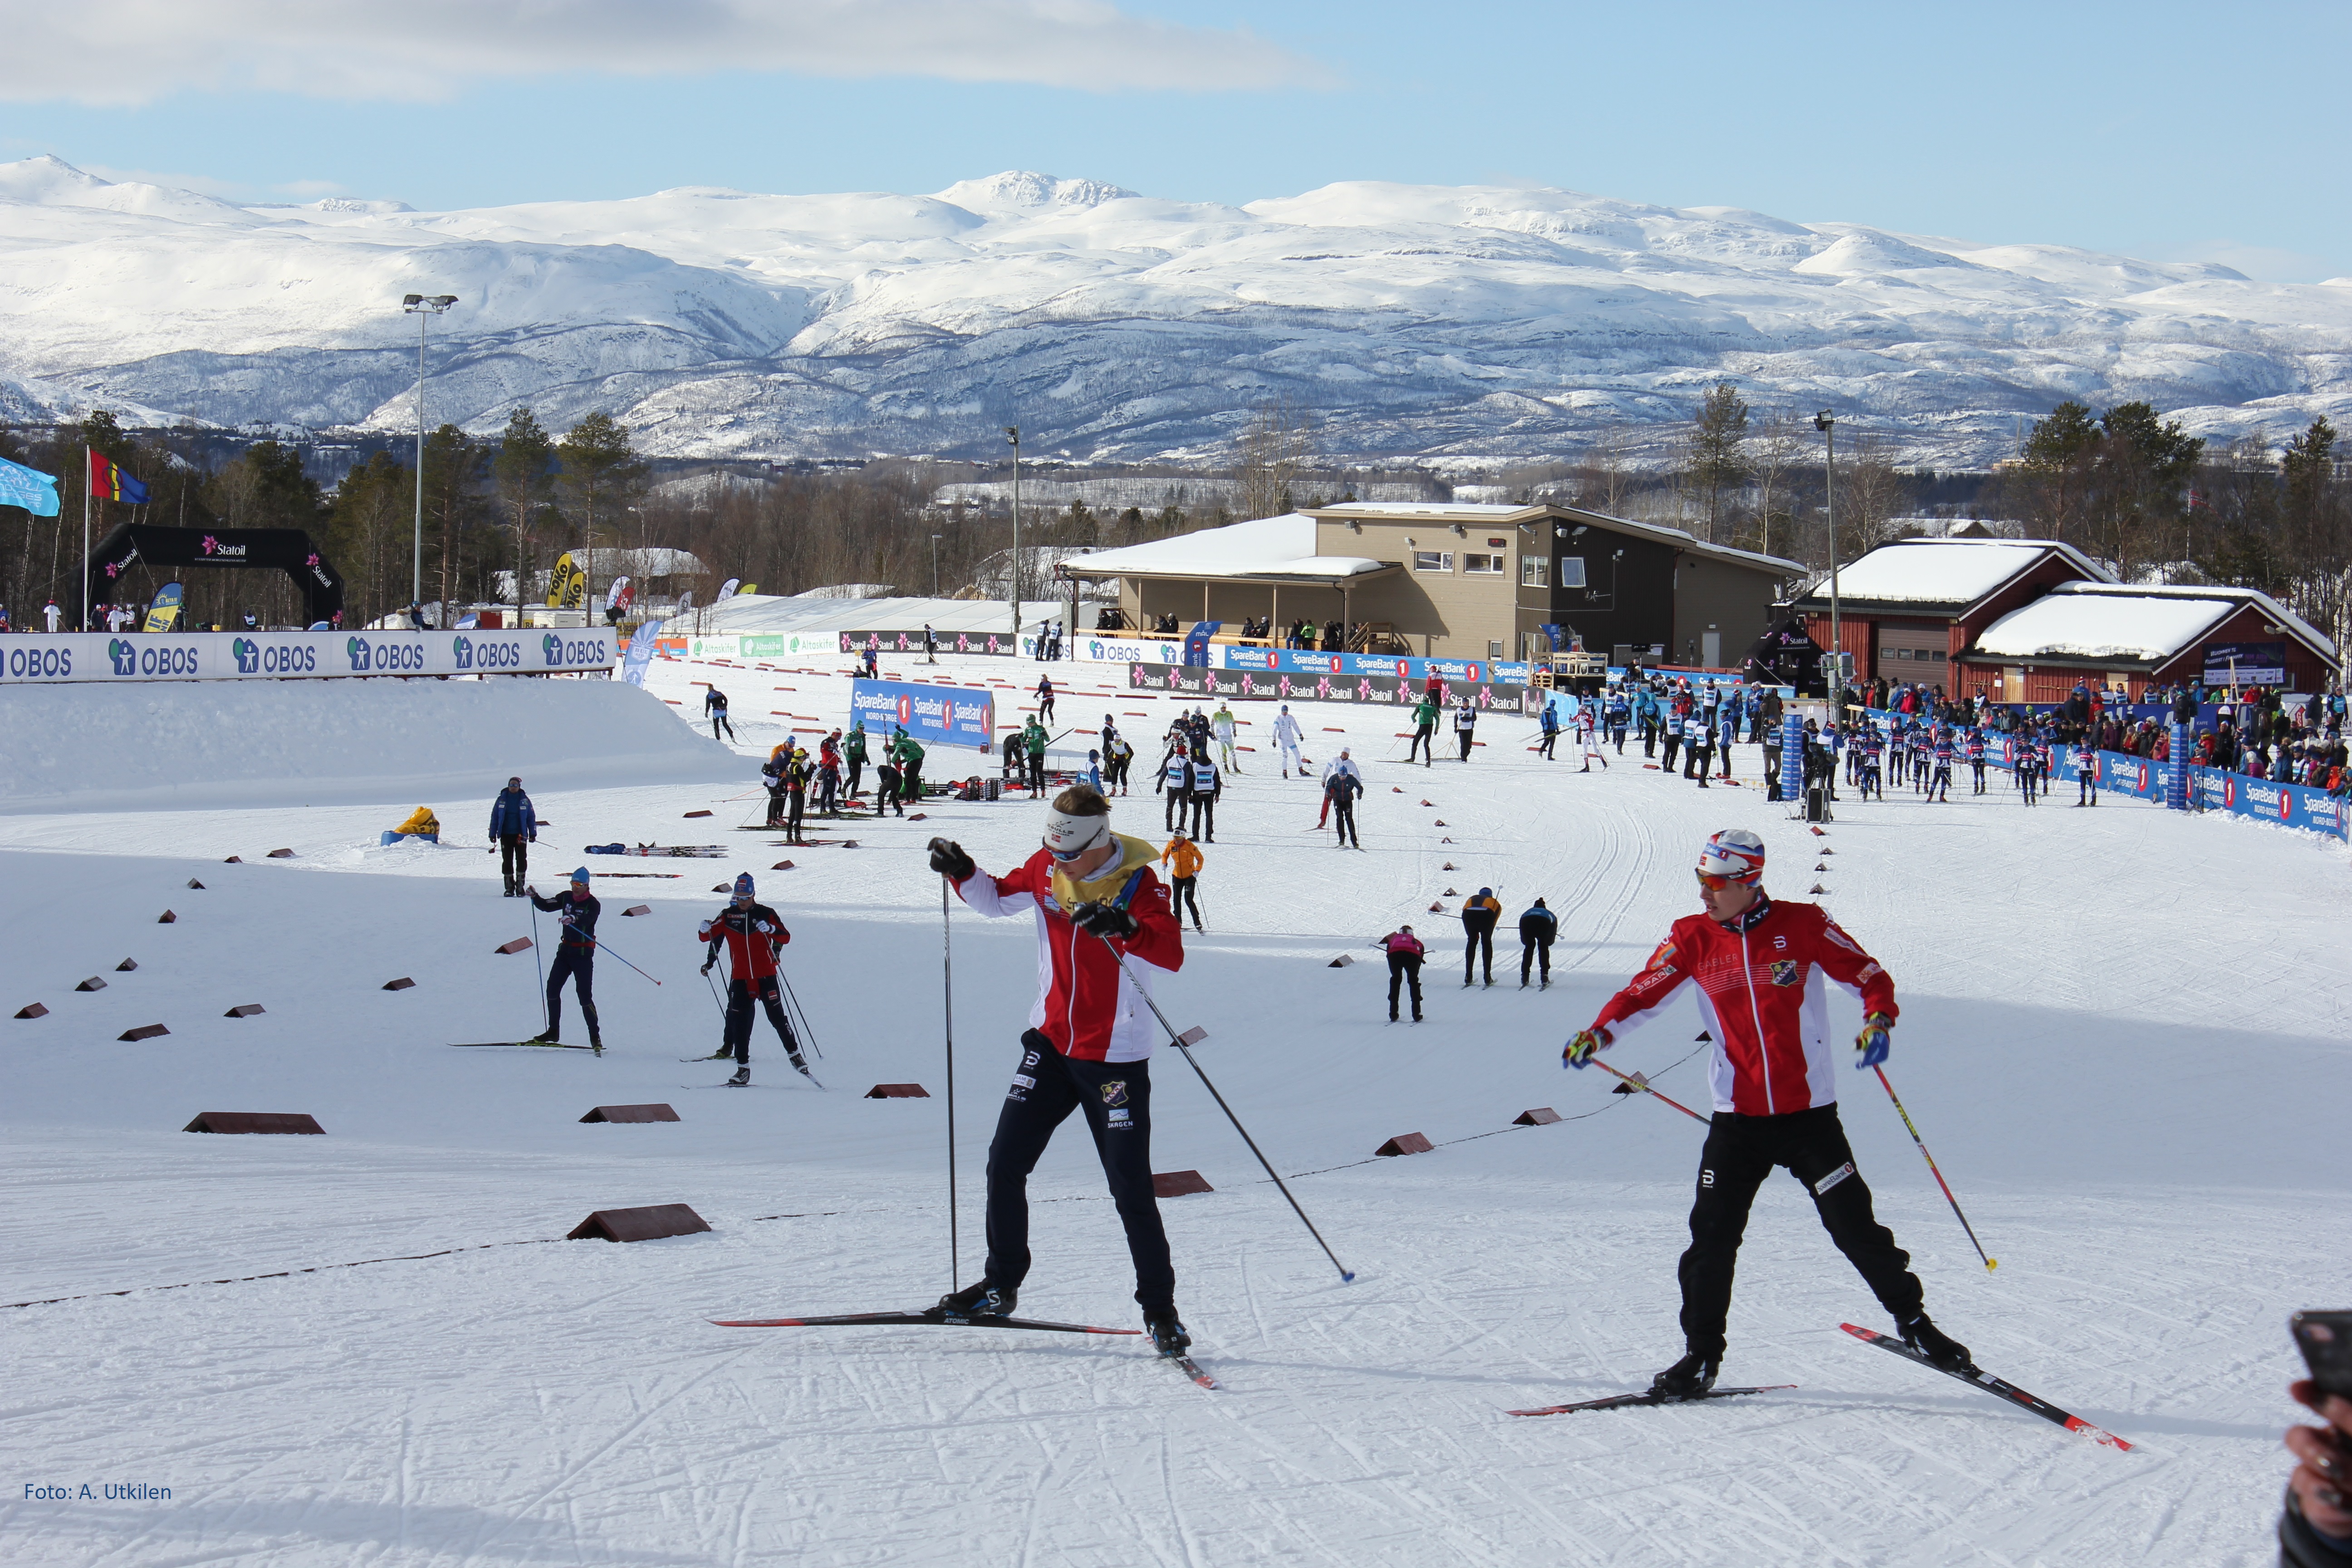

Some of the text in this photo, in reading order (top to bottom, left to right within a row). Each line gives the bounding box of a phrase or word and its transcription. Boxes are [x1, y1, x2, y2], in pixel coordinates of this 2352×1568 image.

[217, 544, 245, 555] Statoil
[118, 549, 137, 571] Statoil
[313, 566, 332, 588] Statoil
[550, 564, 568, 598] TOKO
[705, 643, 736, 654] Altaskifer
[756, 641, 781, 650] Altaskifer
[802, 639, 835, 650] Altaskifer
[850, 641, 866, 649] Statoil
[878, 641, 894, 650] Statoil
[907, 641, 923, 651] Statoil
[936, 641, 953, 651] Statoil
[966, 642, 983, 652] Statoil
[996, 643, 1013, 654] Statoil
[376, 644, 423, 670] OBOS
[477, 642, 520, 667] OBOS
[566, 640, 604, 664] OBOS
[1107, 646, 1140, 661] OBOS
[1230, 649, 1266, 662] SpareBank
[2210, 648, 2231, 657] VELKOMMEN
[10, 648, 71, 677] OBOS
[142, 647, 198, 675] OBOS
[264, 646, 315, 672] OBOS
[1293, 653, 1329, 665] SpareBank
[1356, 657, 1396, 670] SpareBank
[1494, 666, 1527, 677] SpareBa
[1144, 675, 1163, 687] Statoil
[1180, 677, 1199, 691] Statoil
[1215, 681, 1237, 694] Statoil
[1252, 683, 1275, 696] Statoil
[1290, 686, 1314, 698] Statoil
[1329, 687, 1352, 700] Statoil
[1370, 689, 1392, 701] Statoil
[854, 691, 897, 710] SpareBank
[914, 696, 943, 716] SpareBank
[1490, 696, 1519, 710] Statoil
[866, 712, 897, 722] NORD-NORGE
[954, 701, 981, 721] SpareBank
[922, 718, 943, 728] NORD-NORGE
[961, 723, 981, 733] NORD-NORGE
[2111, 759, 2138, 779] SpareBank
[2246, 783, 2279, 805] SpareBank
[2254, 804, 2278, 817] NORD-NORGE
[2304, 794, 2337, 815] SpareBank
[2313, 816, 2337, 827] NORD-NORGE
[1749, 907, 1769, 923] LYN
[1698, 953, 1738, 970] GABLER
[1779, 966, 1790, 979] LYN
[1637, 971, 1666, 991] SPAR
[1109, 1088, 1119, 1098] LYN
[1817, 1170, 1846, 1192] SpareBank
